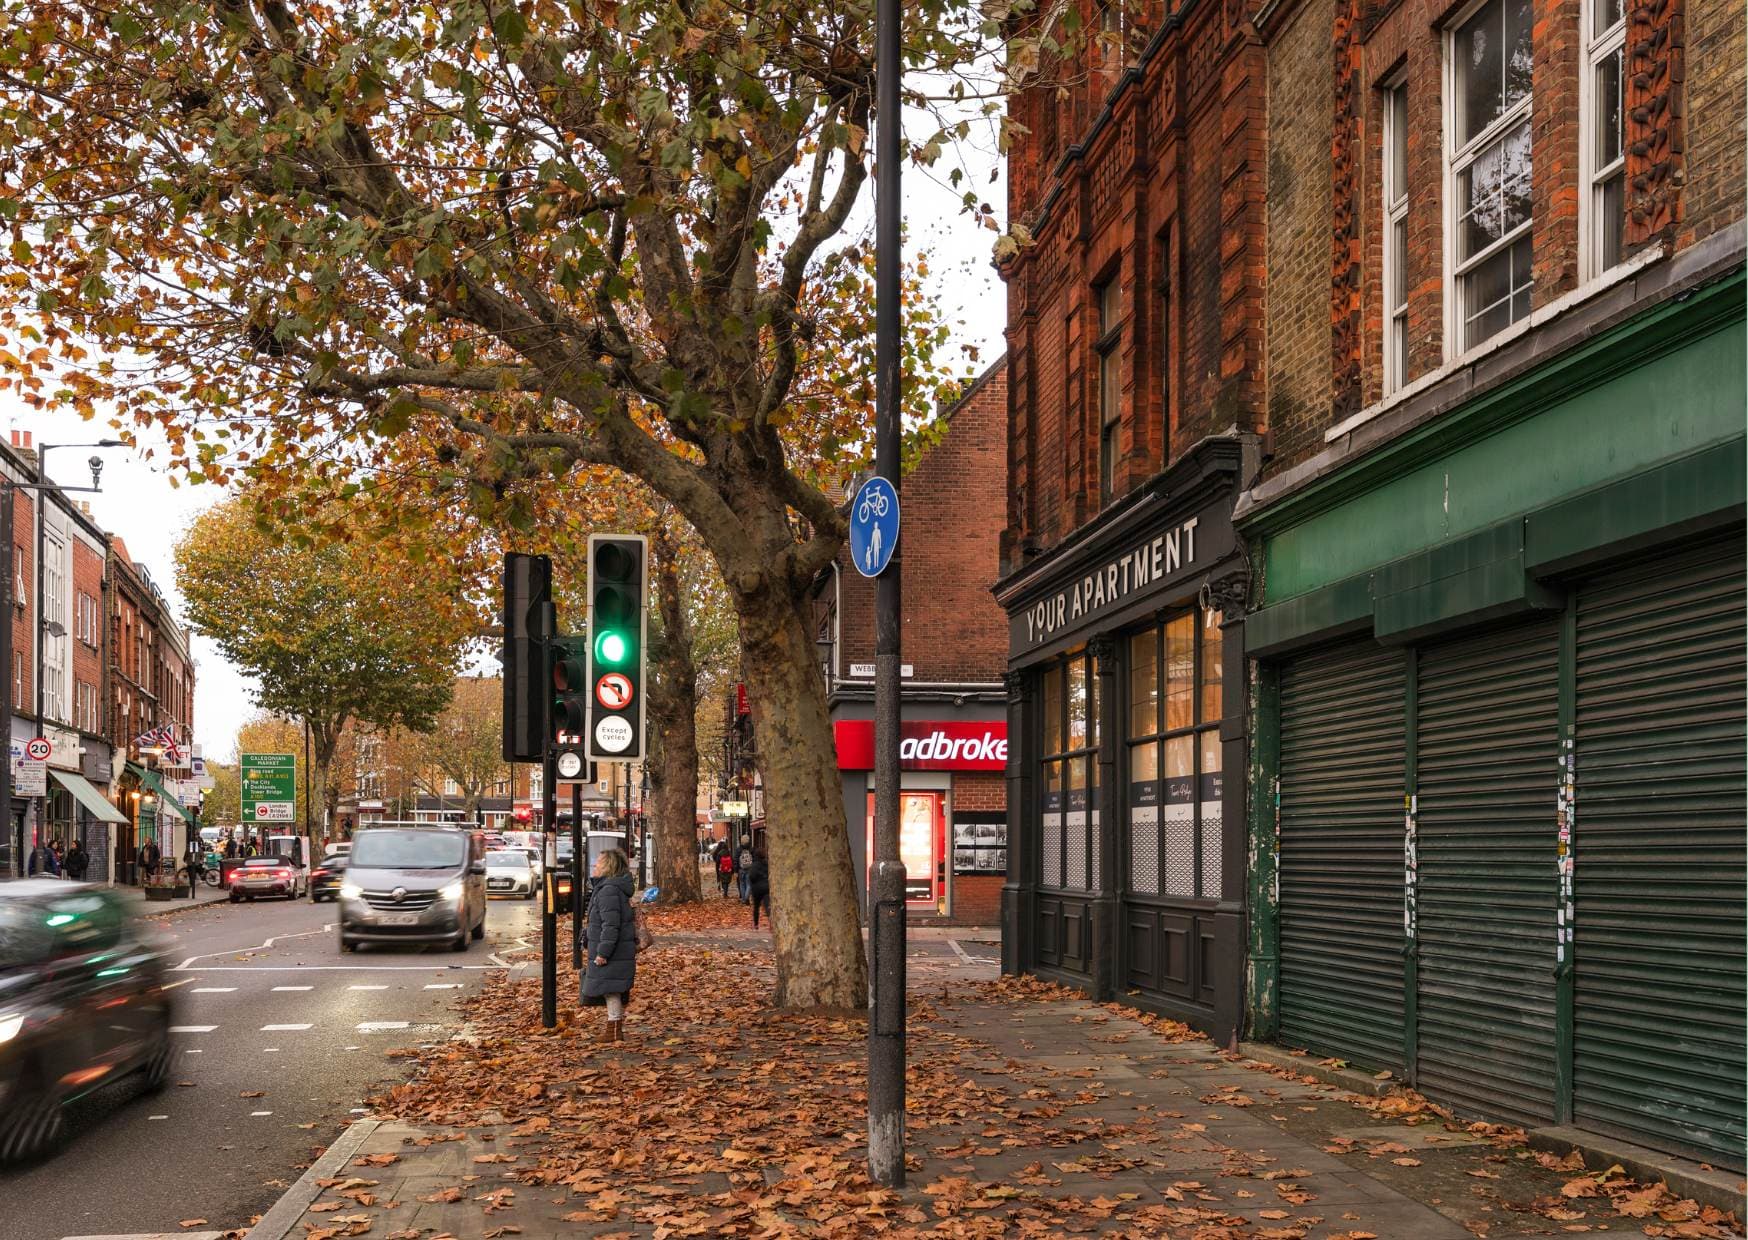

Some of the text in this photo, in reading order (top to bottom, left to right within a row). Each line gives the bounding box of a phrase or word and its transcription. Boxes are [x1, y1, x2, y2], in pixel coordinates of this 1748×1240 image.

[1027, 517, 1198, 642] YOUR APARTMENT
[601, 727, 627, 735] Except
[31, 744, 48, 754] 20
[901, 731, 1008, 761] adbroke
